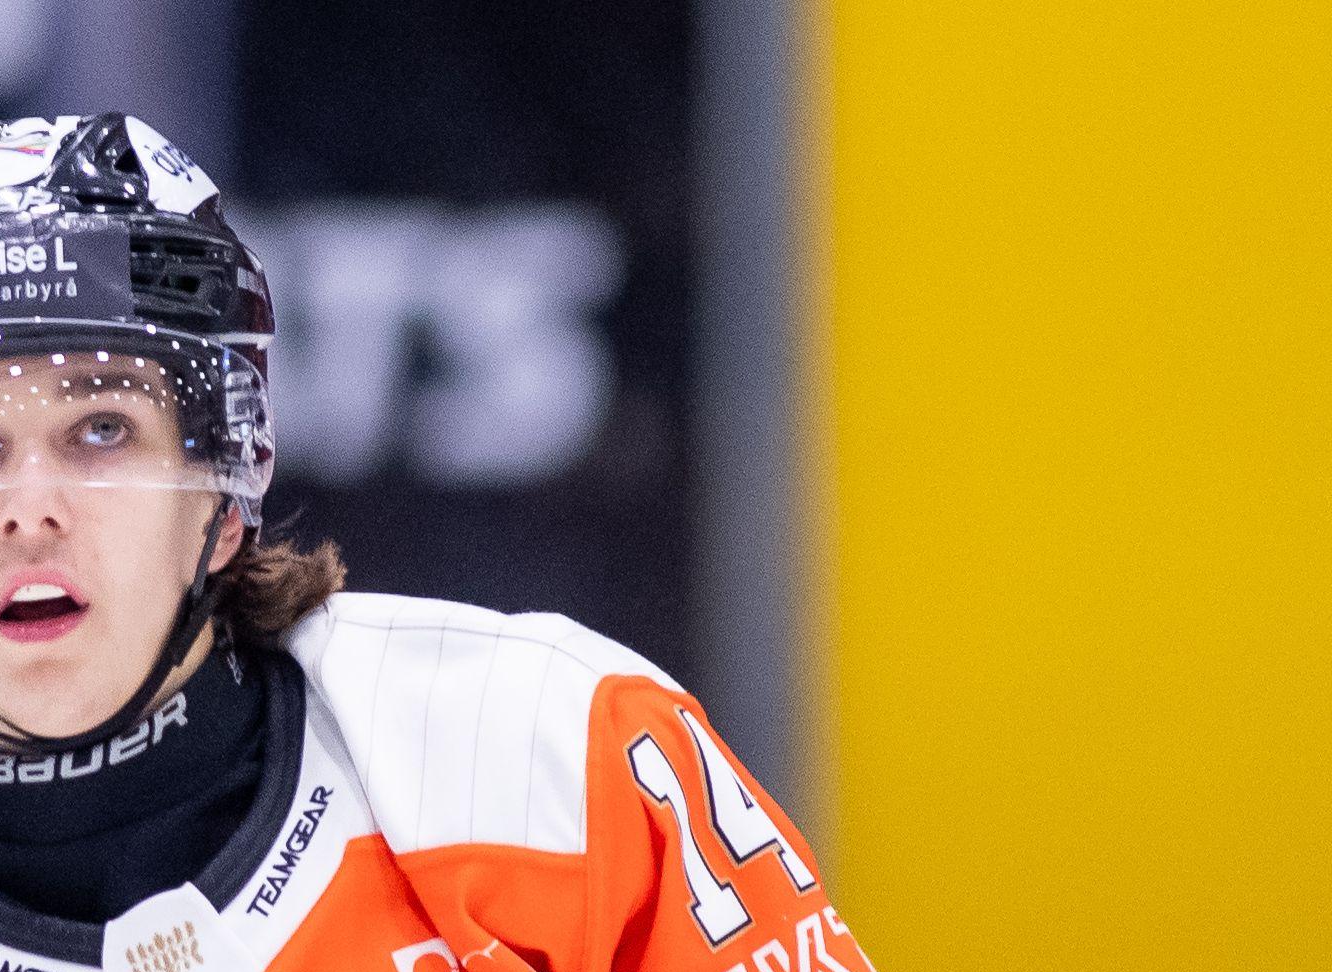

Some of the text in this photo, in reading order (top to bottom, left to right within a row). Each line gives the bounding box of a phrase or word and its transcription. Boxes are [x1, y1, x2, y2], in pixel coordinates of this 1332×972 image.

[54, 236, 78, 272] L
[246, 785, 334, 918] TEAMGEAR
[625, 704, 820, 948] 14
